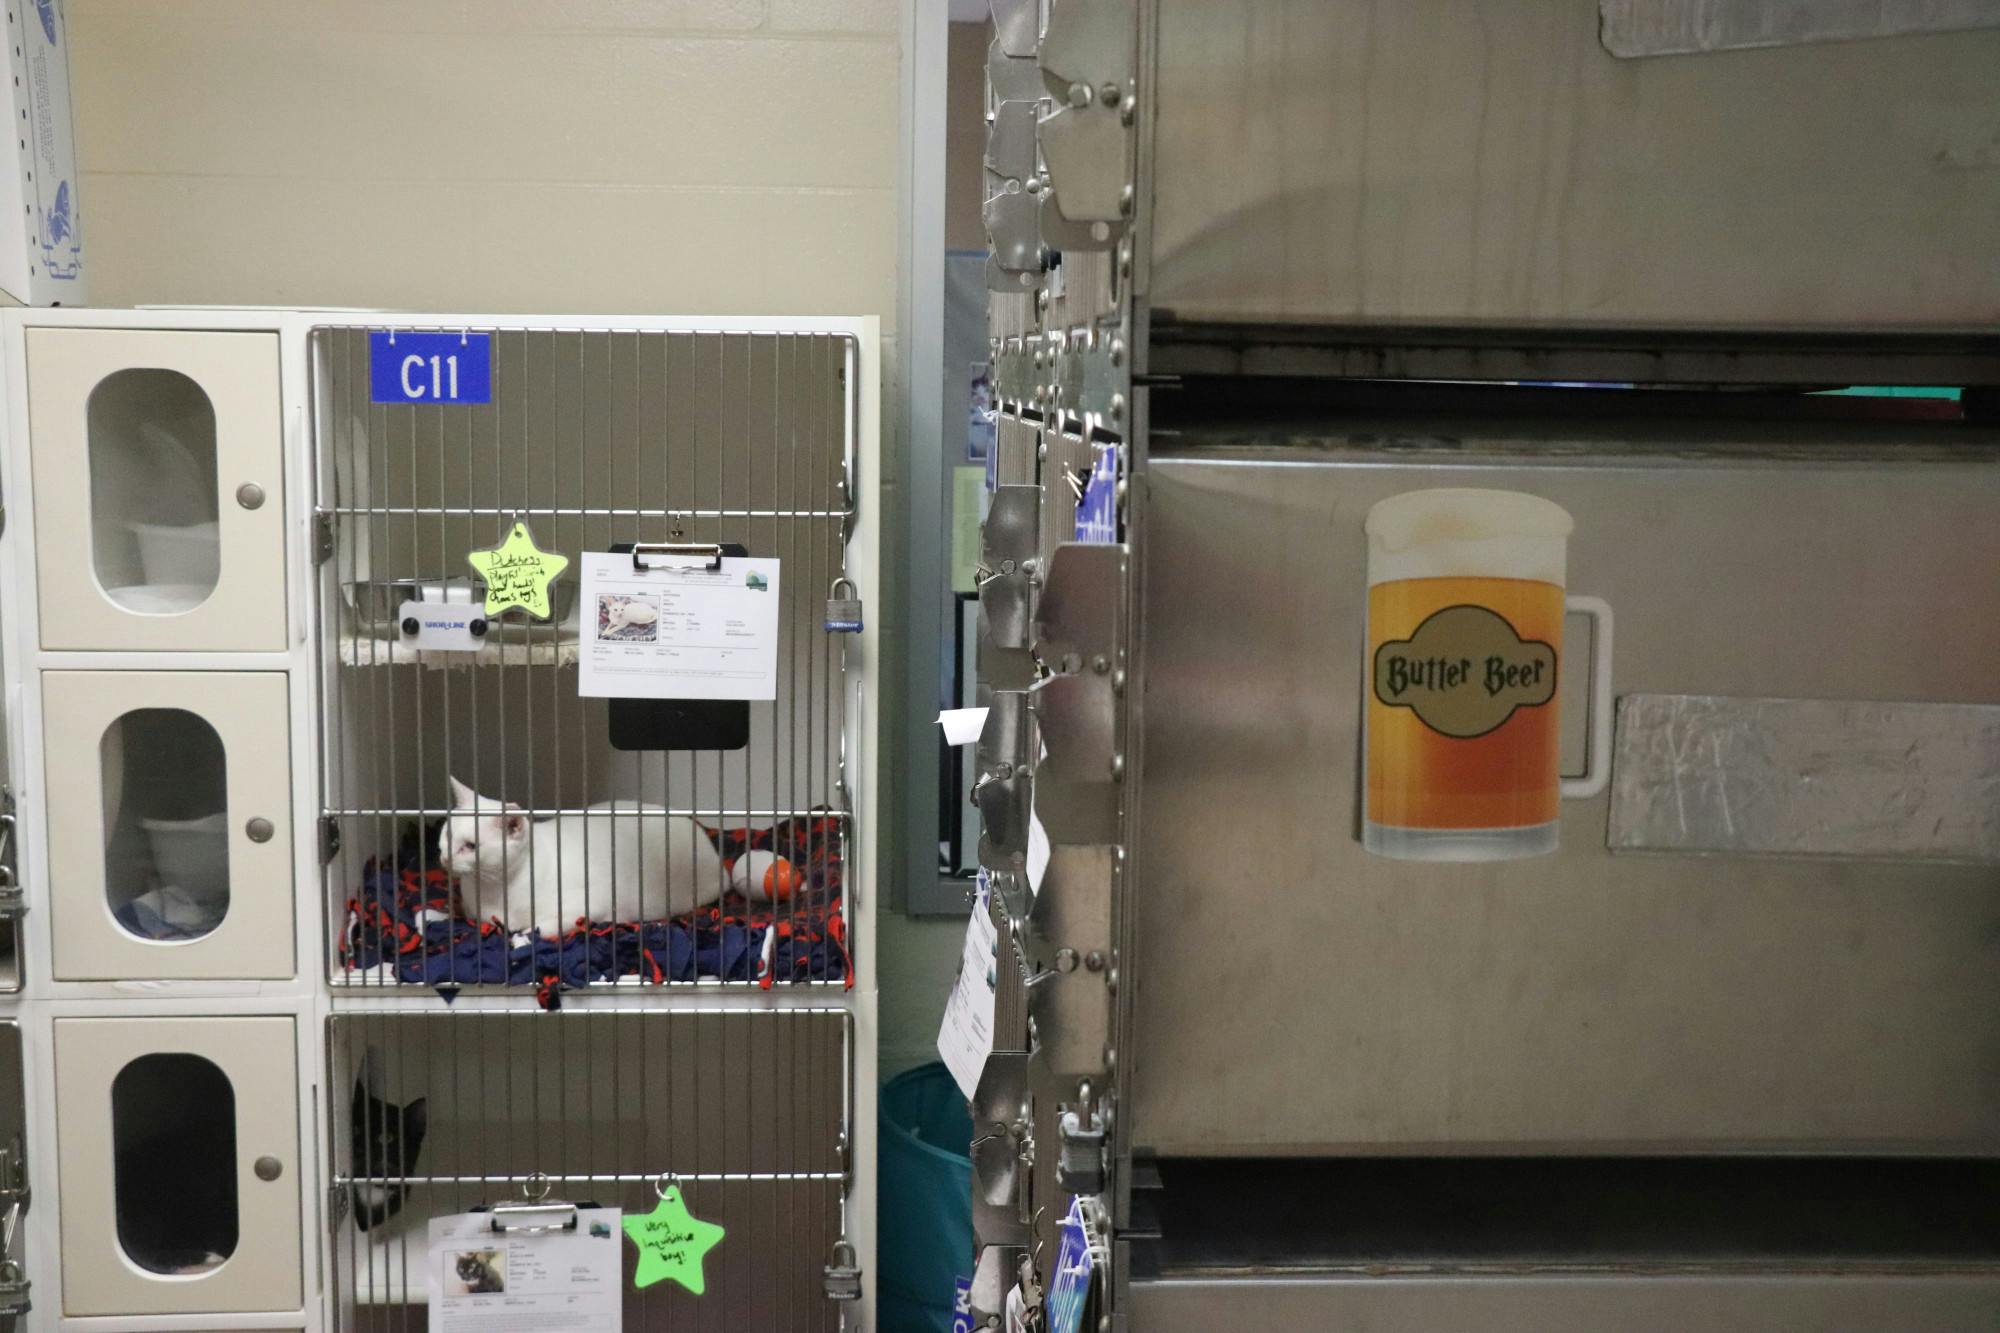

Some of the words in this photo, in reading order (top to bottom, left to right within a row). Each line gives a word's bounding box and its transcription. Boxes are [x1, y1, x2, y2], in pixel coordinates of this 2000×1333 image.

[401, 354, 458, 399] C11
[1387, 655, 1470, 697] Butter
[1483, 655, 1544, 696] Beer
